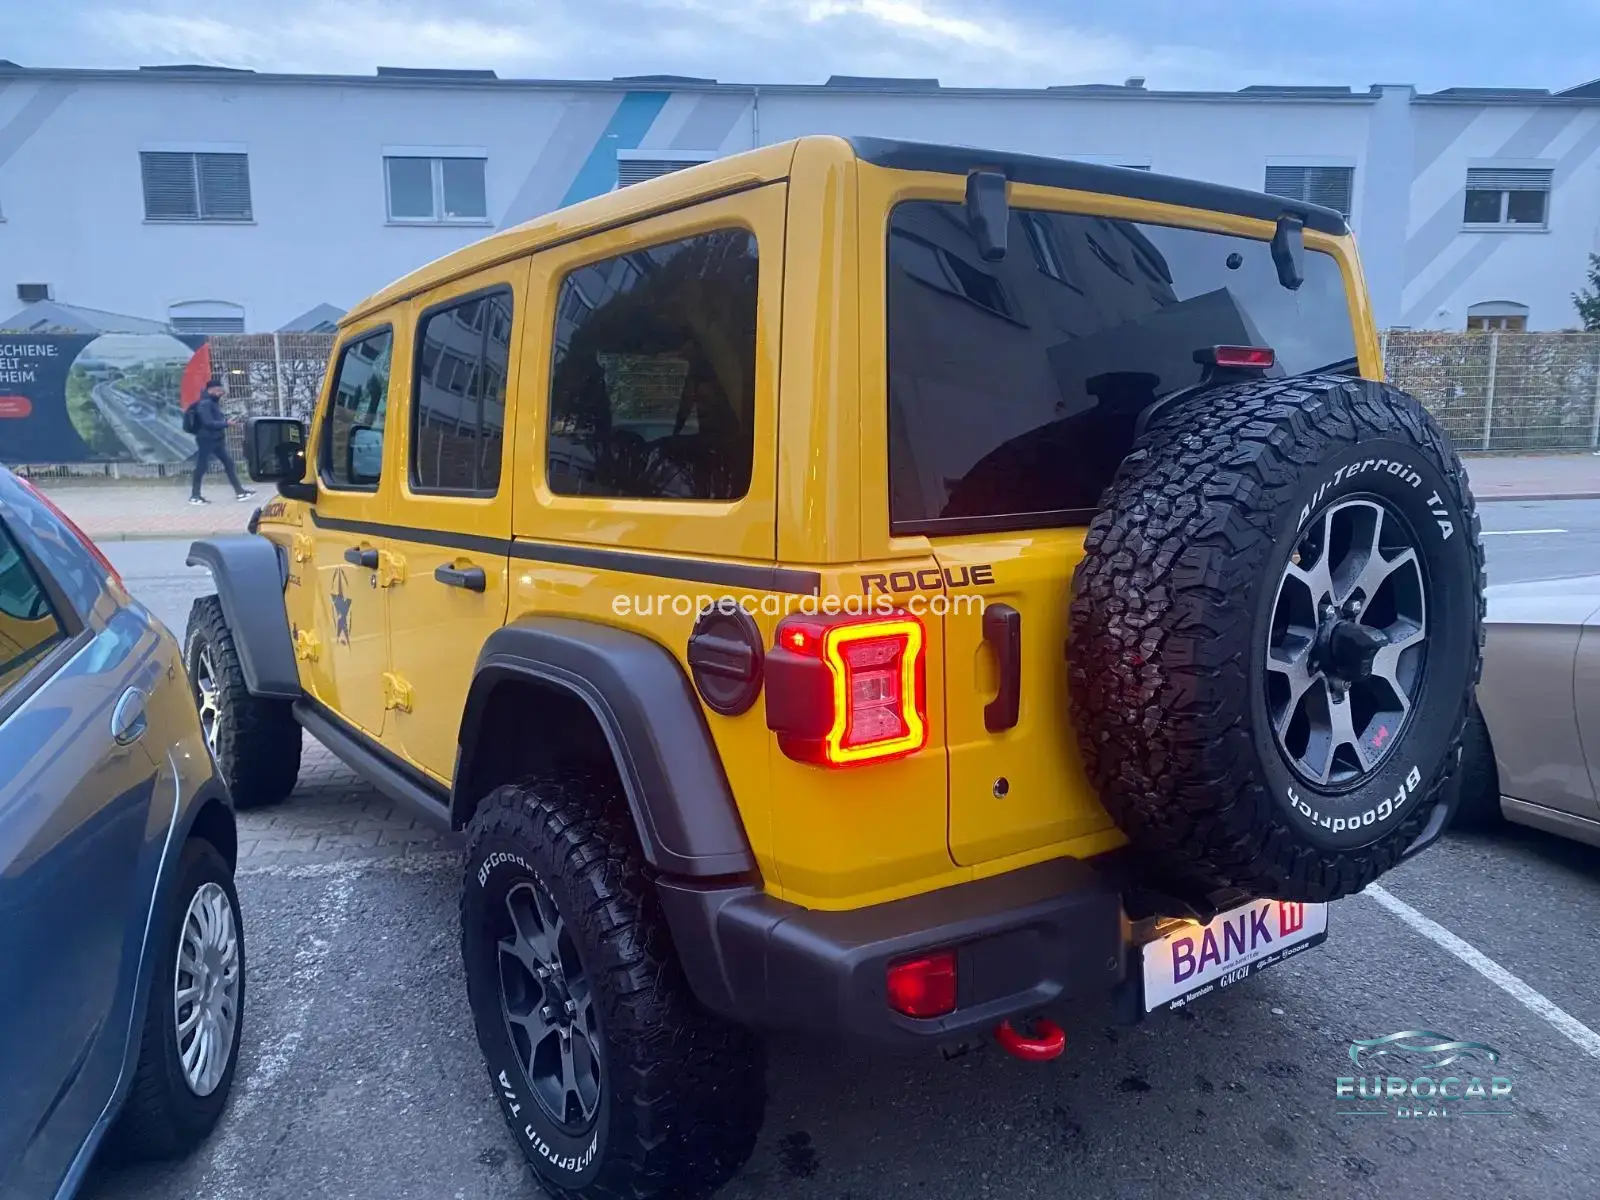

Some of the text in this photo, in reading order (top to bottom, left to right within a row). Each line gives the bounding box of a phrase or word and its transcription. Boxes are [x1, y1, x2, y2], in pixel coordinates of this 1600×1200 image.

[1297, 459, 1422, 533] All-Terrain
[860, 564, 995, 596] ROGUE
[1287, 765, 1421, 834] BFGoodrich
[1171, 903, 1273, 985] BANK
[1186, 985, 1214, 1002] Mannheim
[1220, 965, 1250, 988] GAUCH
[525, 1124, 598, 1173] All-Terrain
